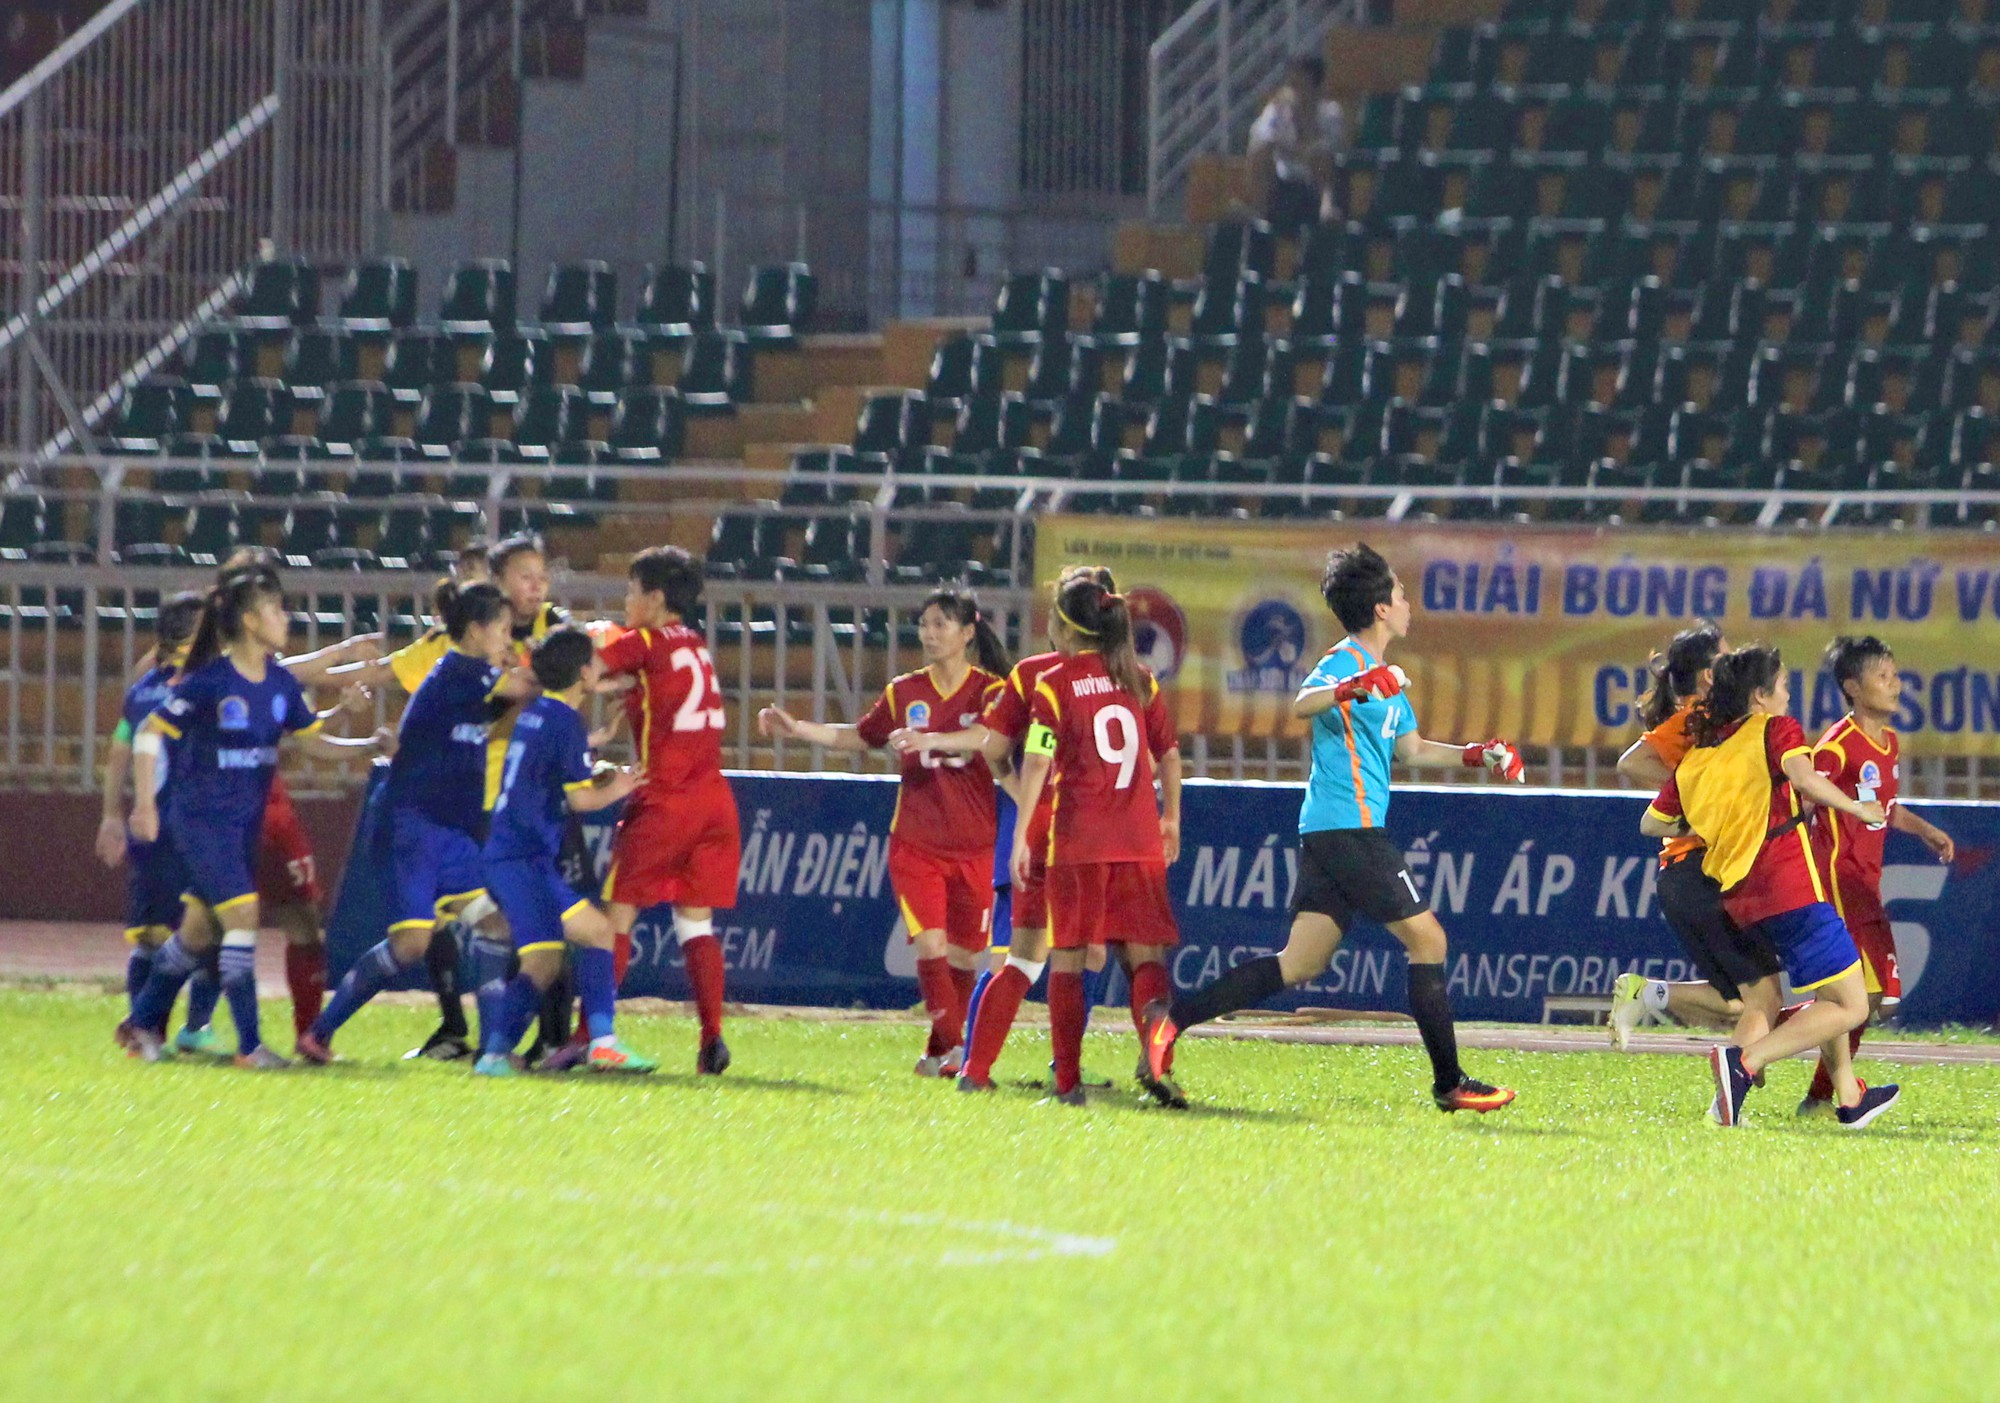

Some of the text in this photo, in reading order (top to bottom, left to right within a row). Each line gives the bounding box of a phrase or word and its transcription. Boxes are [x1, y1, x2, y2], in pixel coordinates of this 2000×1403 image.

[1422, 541, 1541, 614] GIẢI
[1956, 568, 2000, 622] V
[1093, 704, 1139, 790] 9
[738, 808, 891, 914] ẪN ĐIỆN
[1397, 869, 1421, 904] 1
[1491, 839, 1576, 917] ÁP
[628, 922, 777, 971] SYEM
[1296, 949, 1390, 995] SIN
